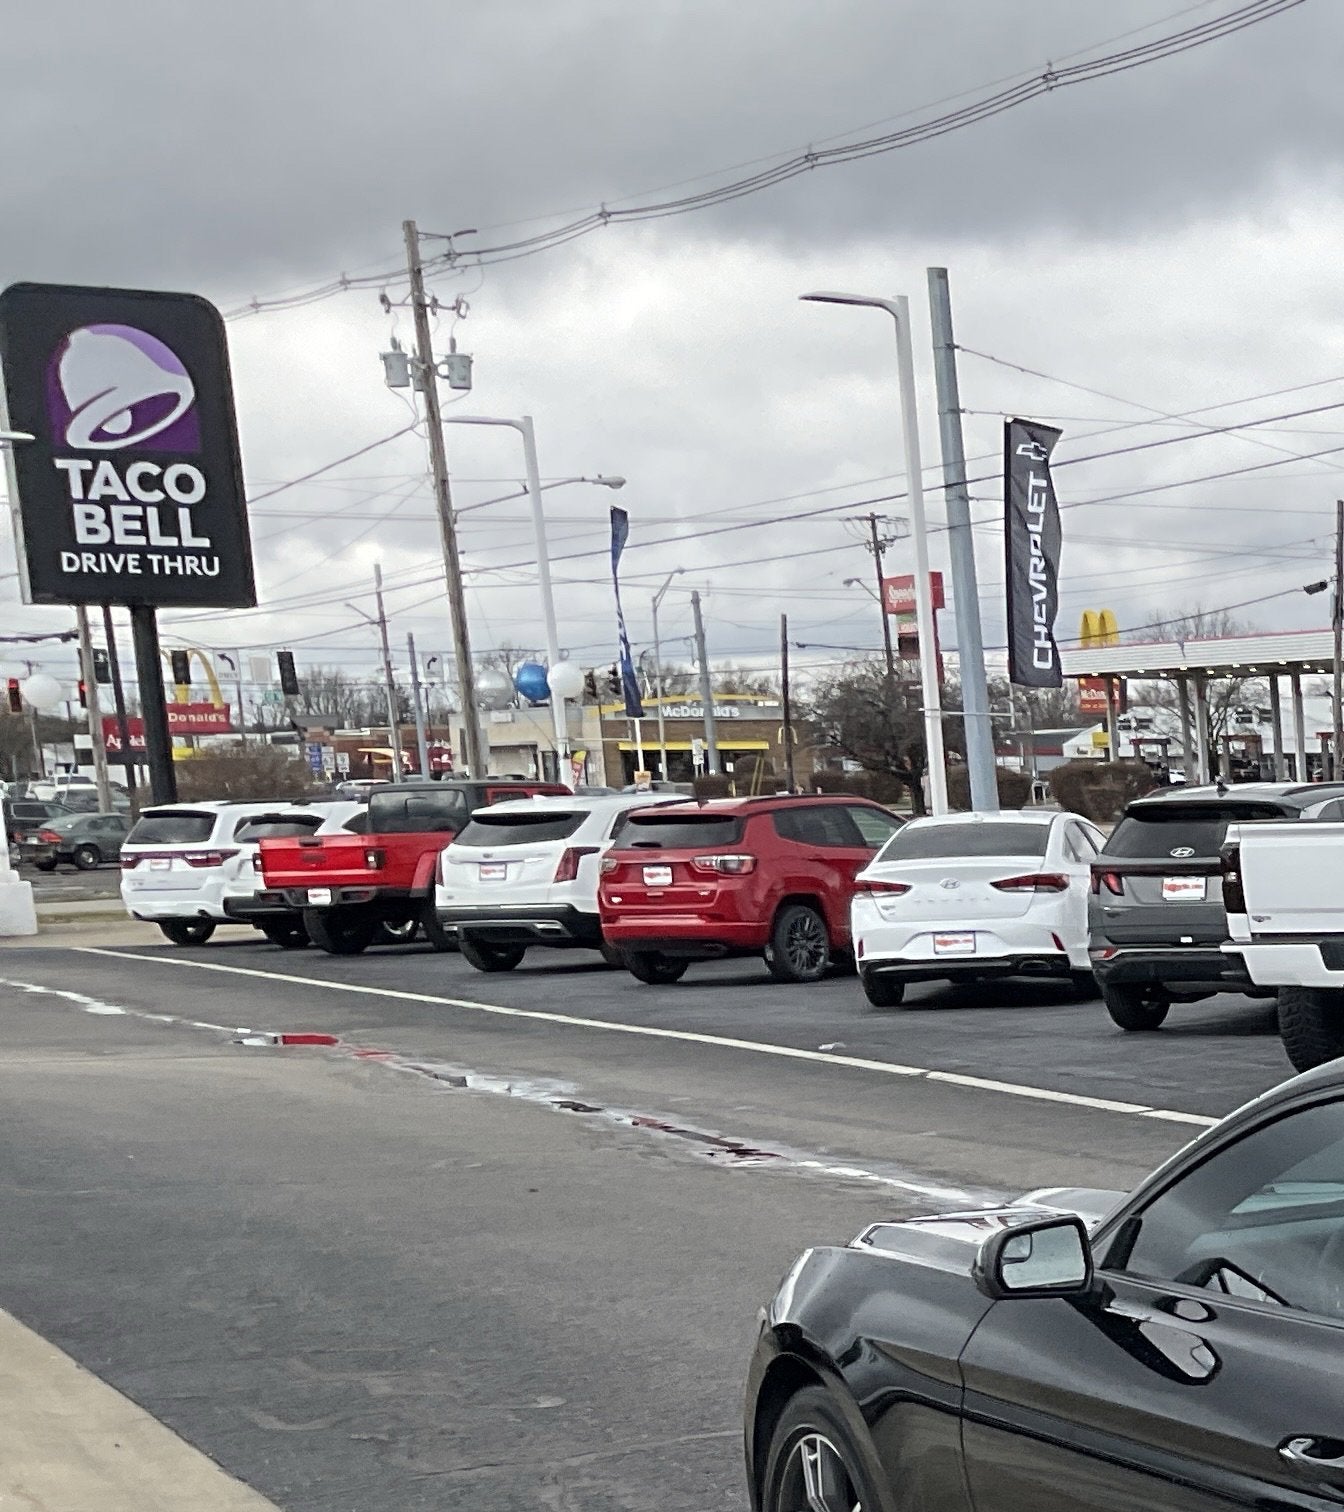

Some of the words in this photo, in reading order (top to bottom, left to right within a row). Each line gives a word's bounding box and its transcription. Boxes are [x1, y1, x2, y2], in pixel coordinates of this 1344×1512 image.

[54, 458, 207, 505] TACO
[73, 503, 211, 548] BELL
[60, 551, 142, 574] DRIVE
[147, 554, 220, 576] THRU
[1026, 470, 1053, 670] CHEVROLET
[168, 712, 227, 723] Donald's
